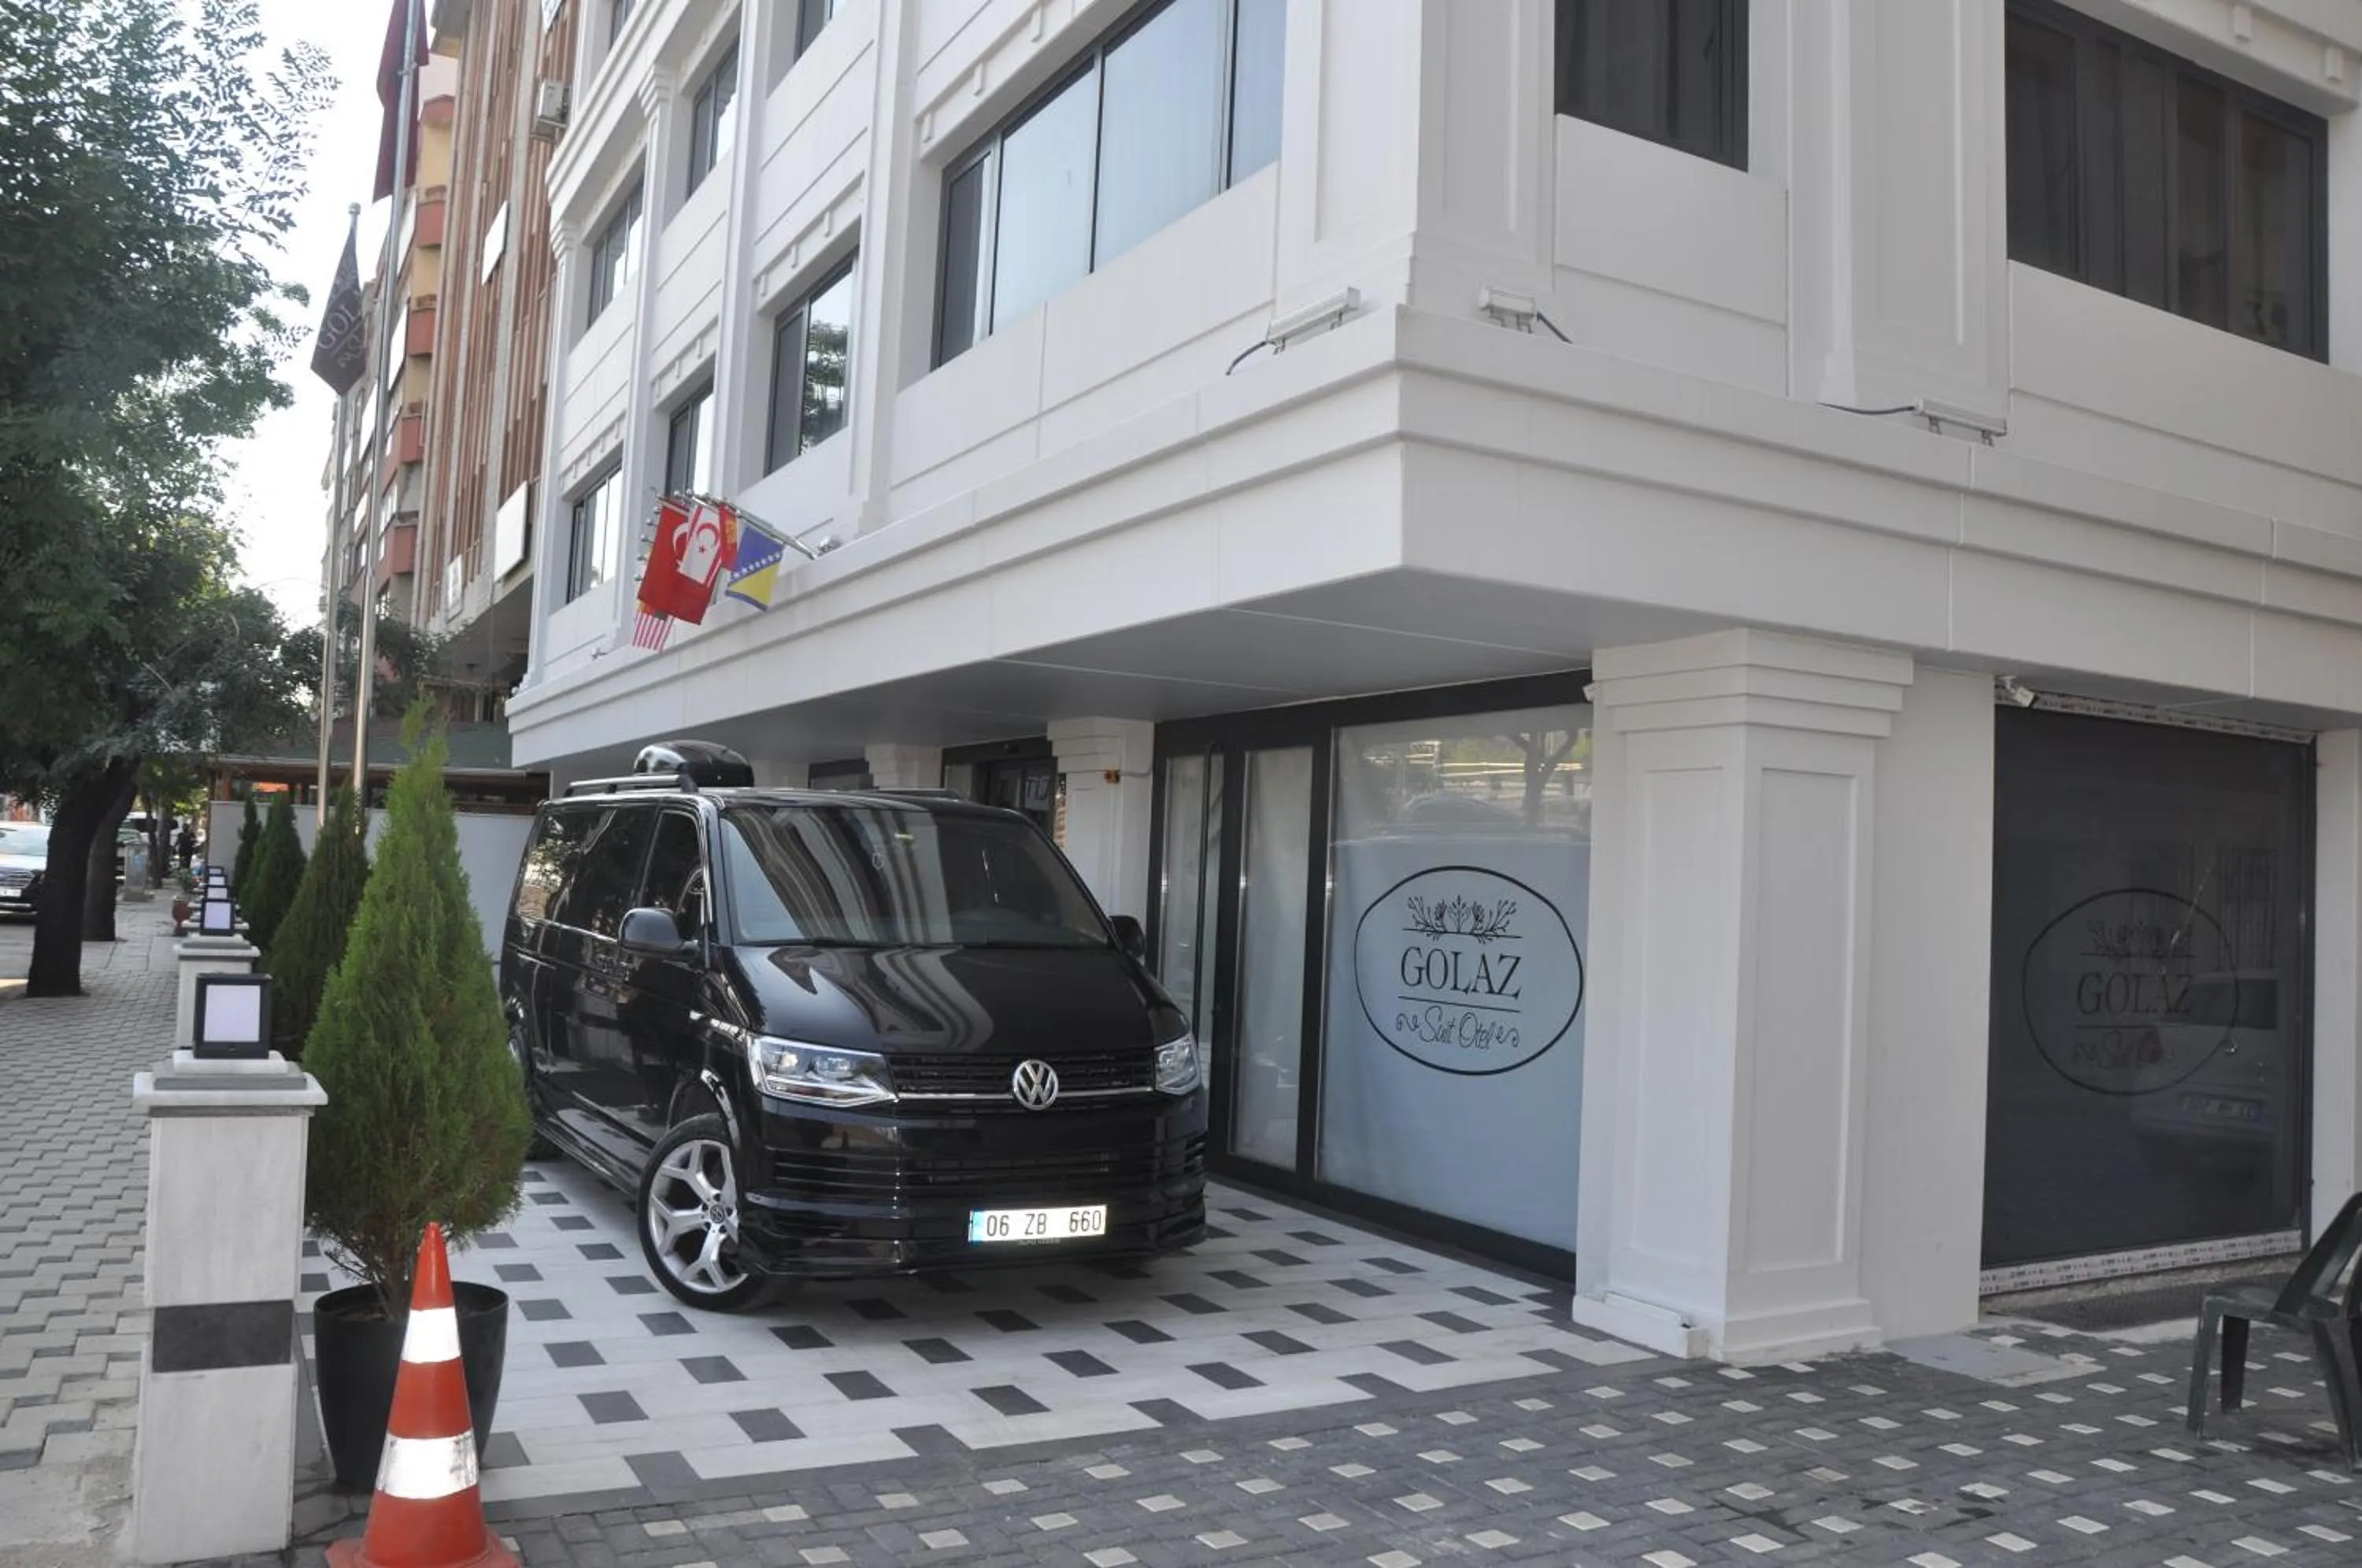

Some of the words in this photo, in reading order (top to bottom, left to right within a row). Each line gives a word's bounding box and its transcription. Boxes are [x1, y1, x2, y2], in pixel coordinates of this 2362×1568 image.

[1401, 946, 1521, 1000] GOLAZ
[2077, 971, 2192, 1015] GOLAZ
[987, 1214, 1010, 1237] 06
[1024, 1212, 1047, 1235] ZB
[1069, 1209, 1101, 1233] 660
